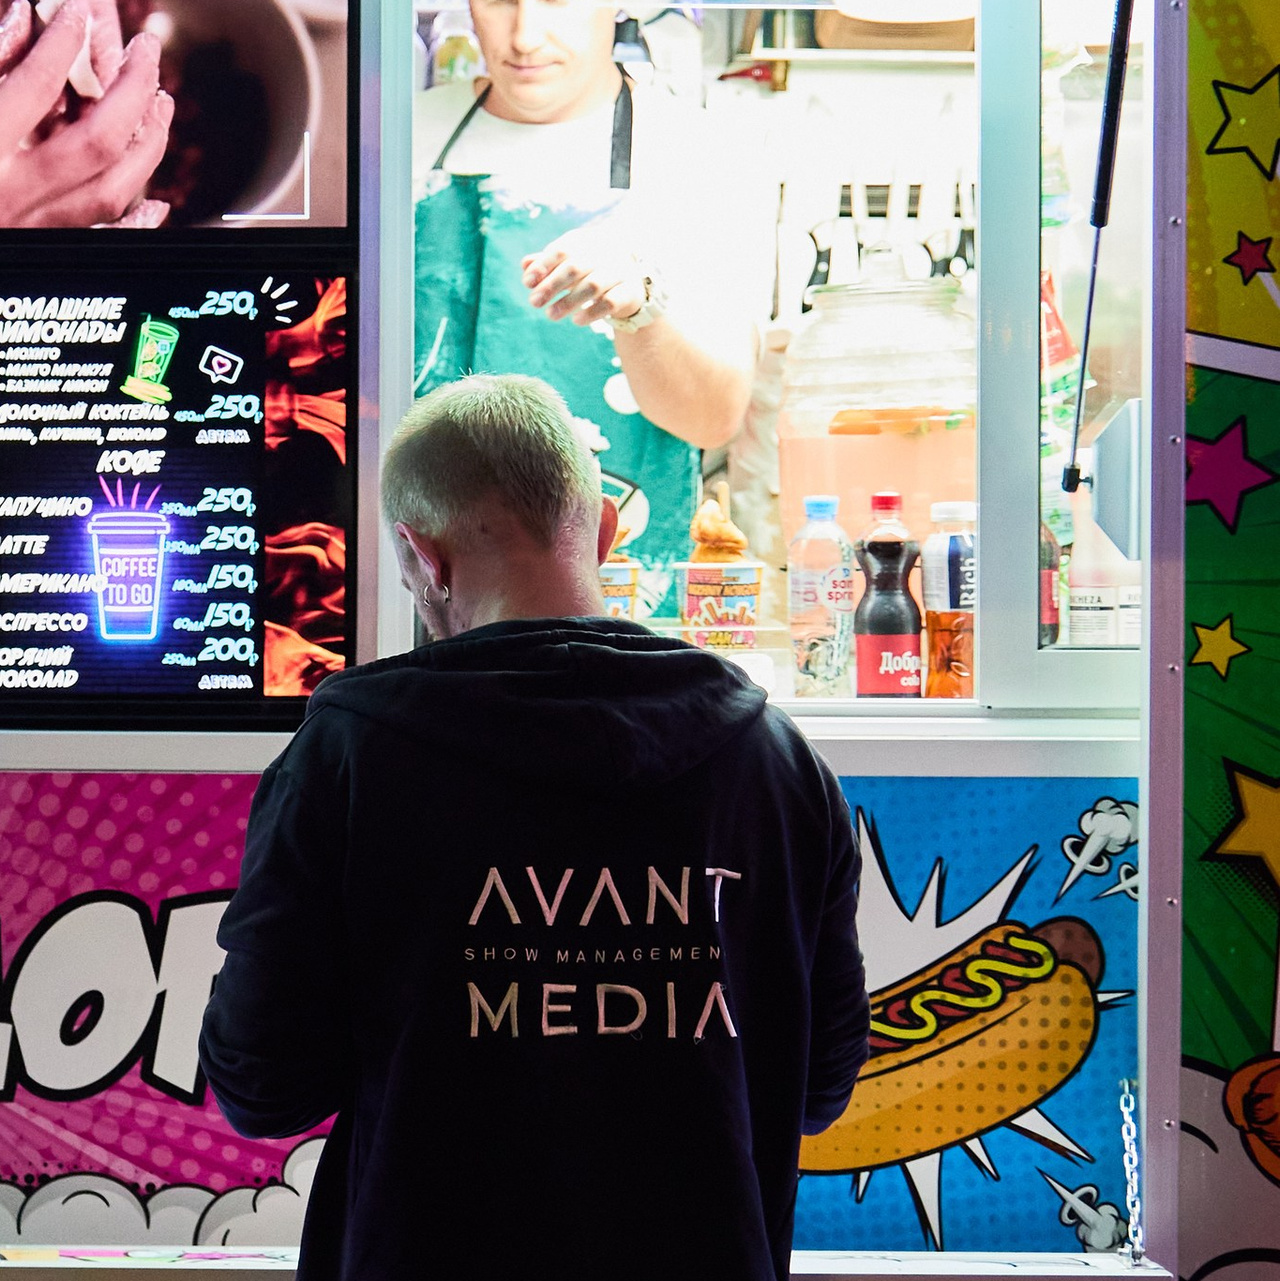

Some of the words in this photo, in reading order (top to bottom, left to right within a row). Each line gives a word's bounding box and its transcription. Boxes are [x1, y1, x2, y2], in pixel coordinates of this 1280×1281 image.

[95, 449, 166, 475] КОФЕ
[101, 557, 158, 577] COFFEE
[106, 583, 127, 605] TO
[130, 583, 153, 605] GO
[468, 866, 742, 926] AVANT
[464, 947, 539, 961] SHOW
[556, 946, 721, 964] MANAGEMEN
[467, 982, 738, 1038] MEDIA
